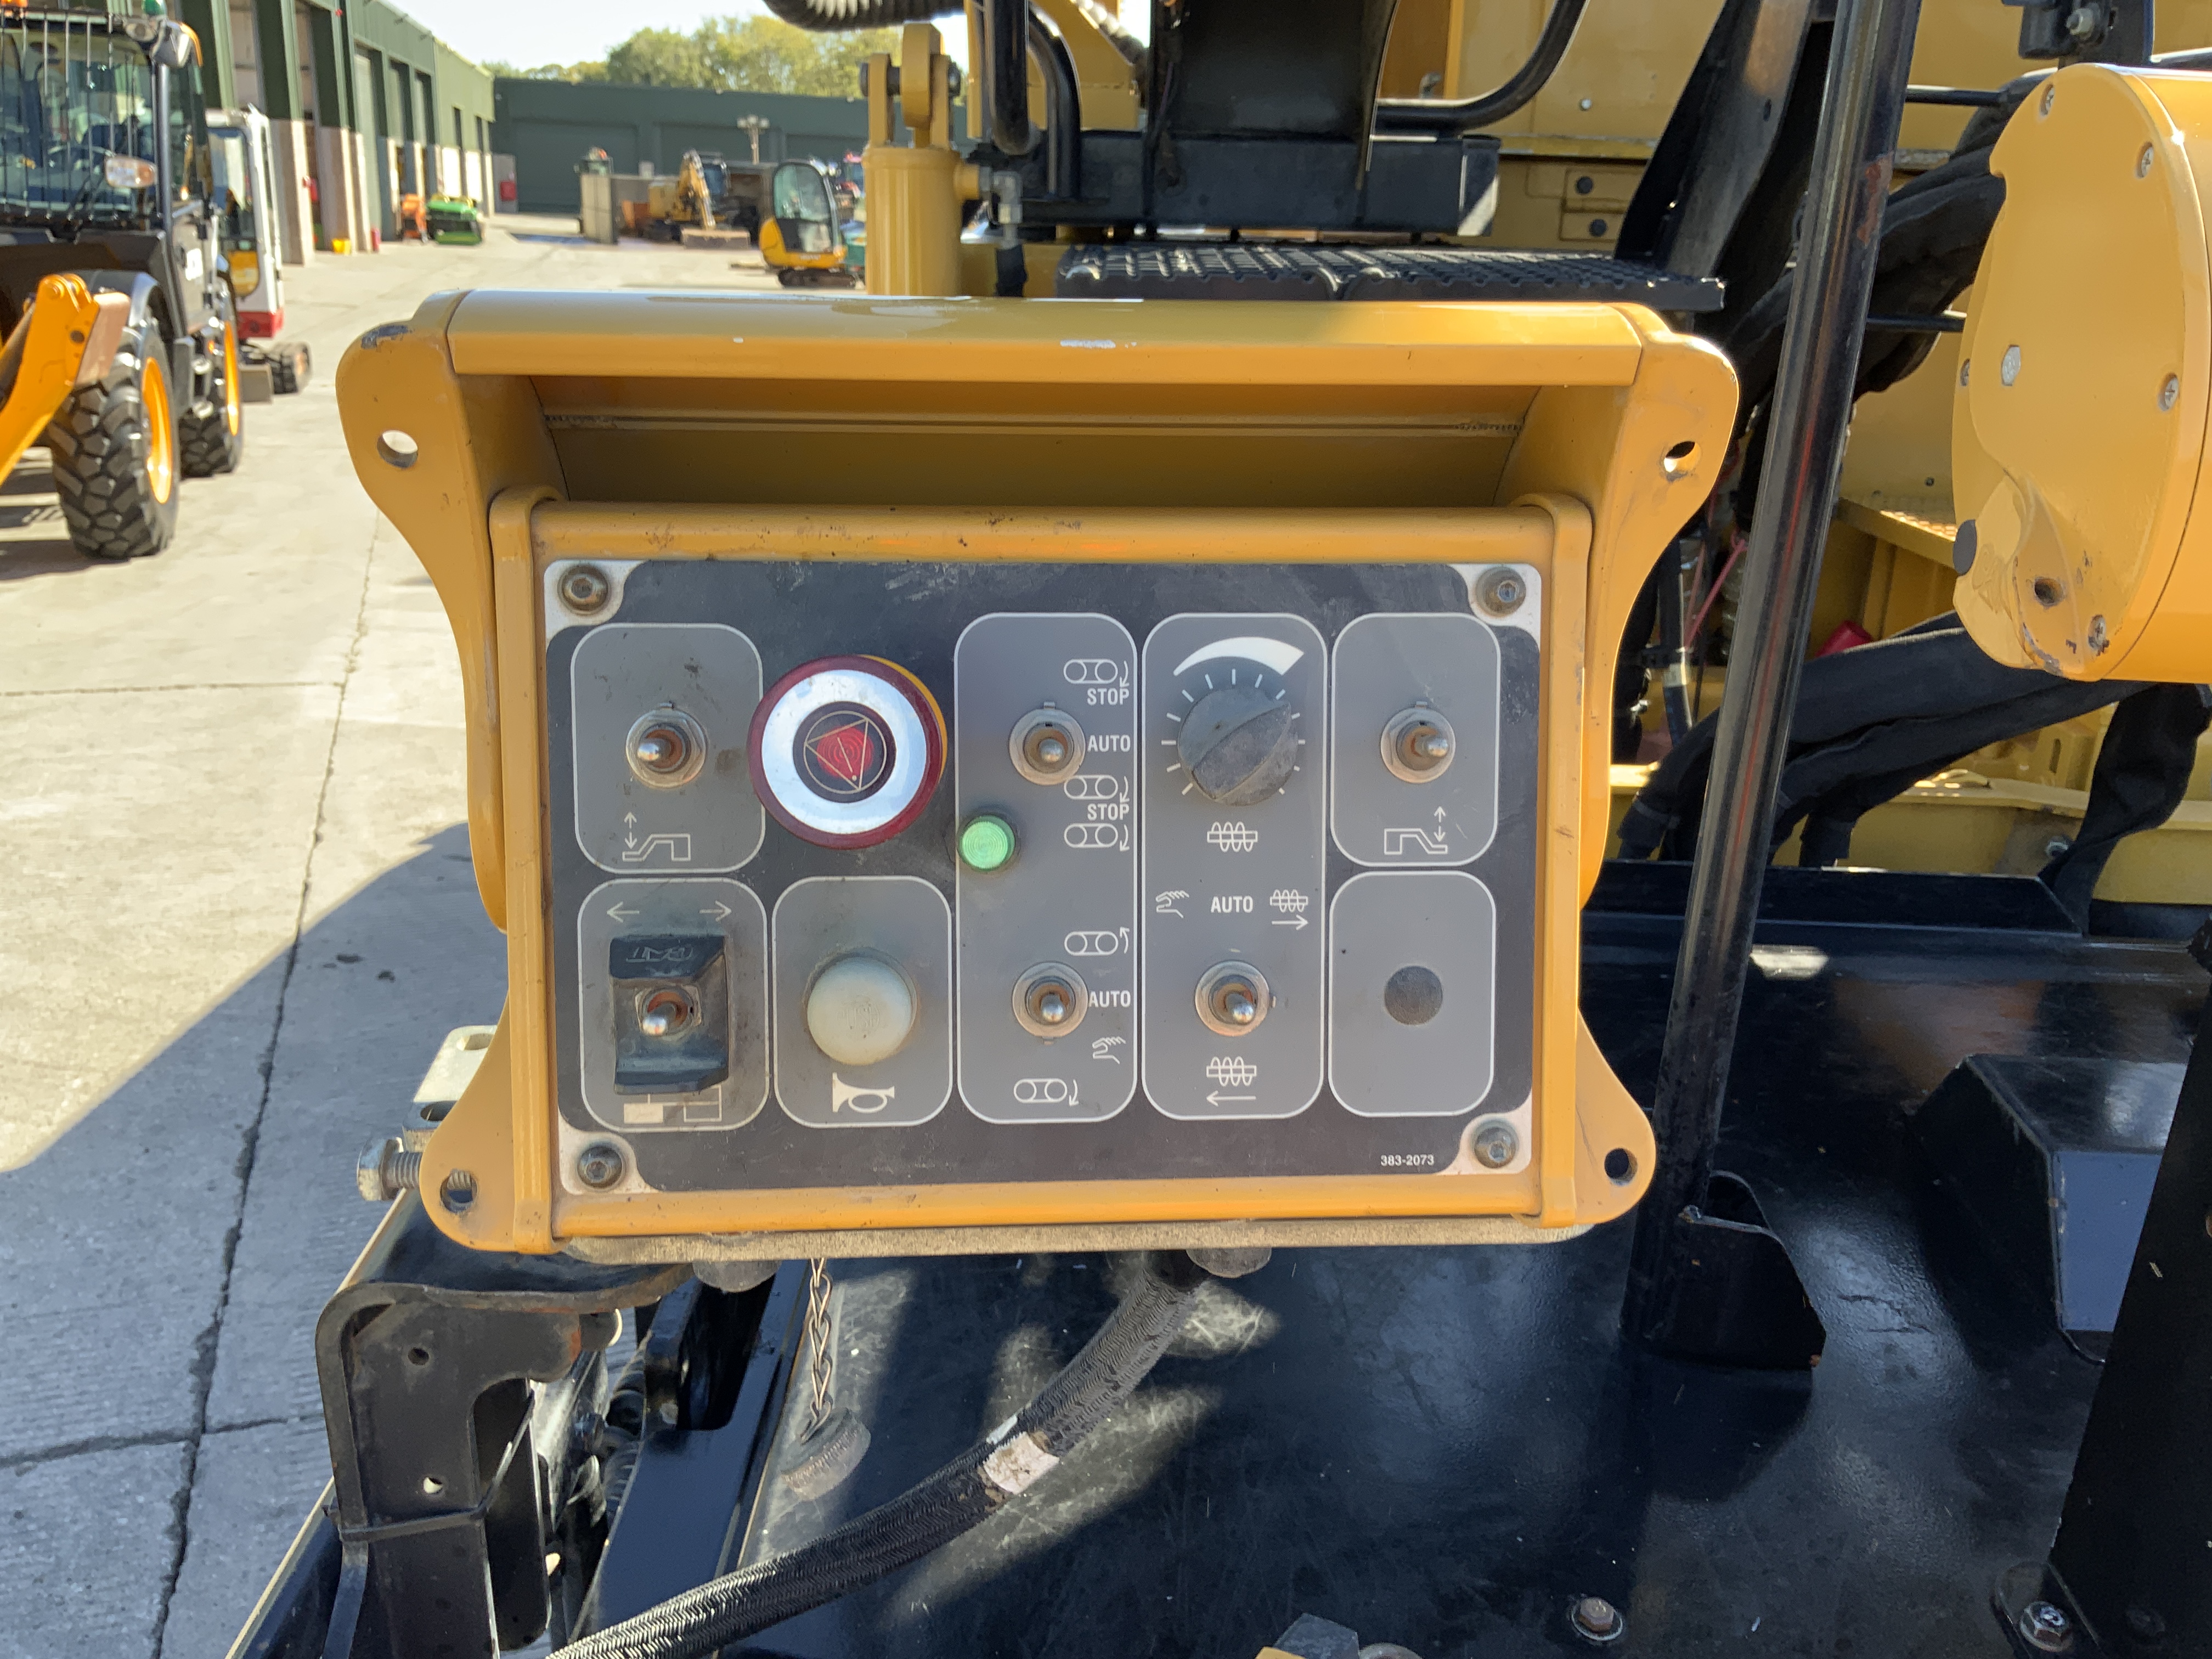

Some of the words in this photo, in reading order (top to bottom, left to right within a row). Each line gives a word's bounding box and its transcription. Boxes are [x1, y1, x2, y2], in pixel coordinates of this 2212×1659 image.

[1087, 688, 1130, 706] STOP
[1087, 735, 1131, 752] AUTO
[1087, 803, 1130, 821] STOP
[1210, 895, 1253, 913] AUTO
[1088, 990, 1131, 1008] AUTO
[1380, 1154, 1435, 1166] 383-2073
